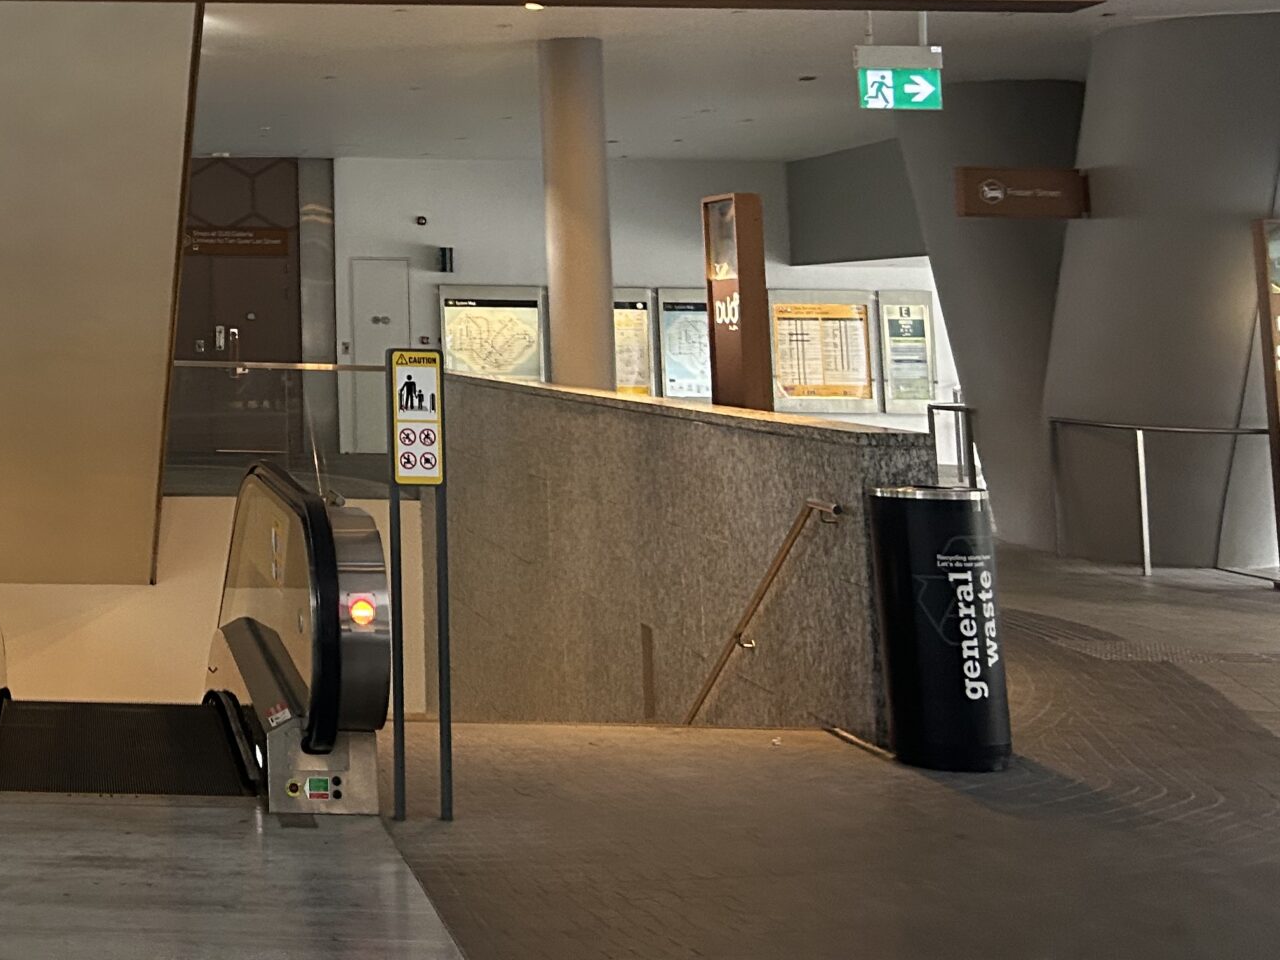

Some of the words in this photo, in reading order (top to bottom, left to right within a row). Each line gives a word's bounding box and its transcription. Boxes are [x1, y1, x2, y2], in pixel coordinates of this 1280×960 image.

[408, 356, 437, 365] CAUTION
[948, 570, 989, 700] general
[977, 570, 1000, 668] waste
